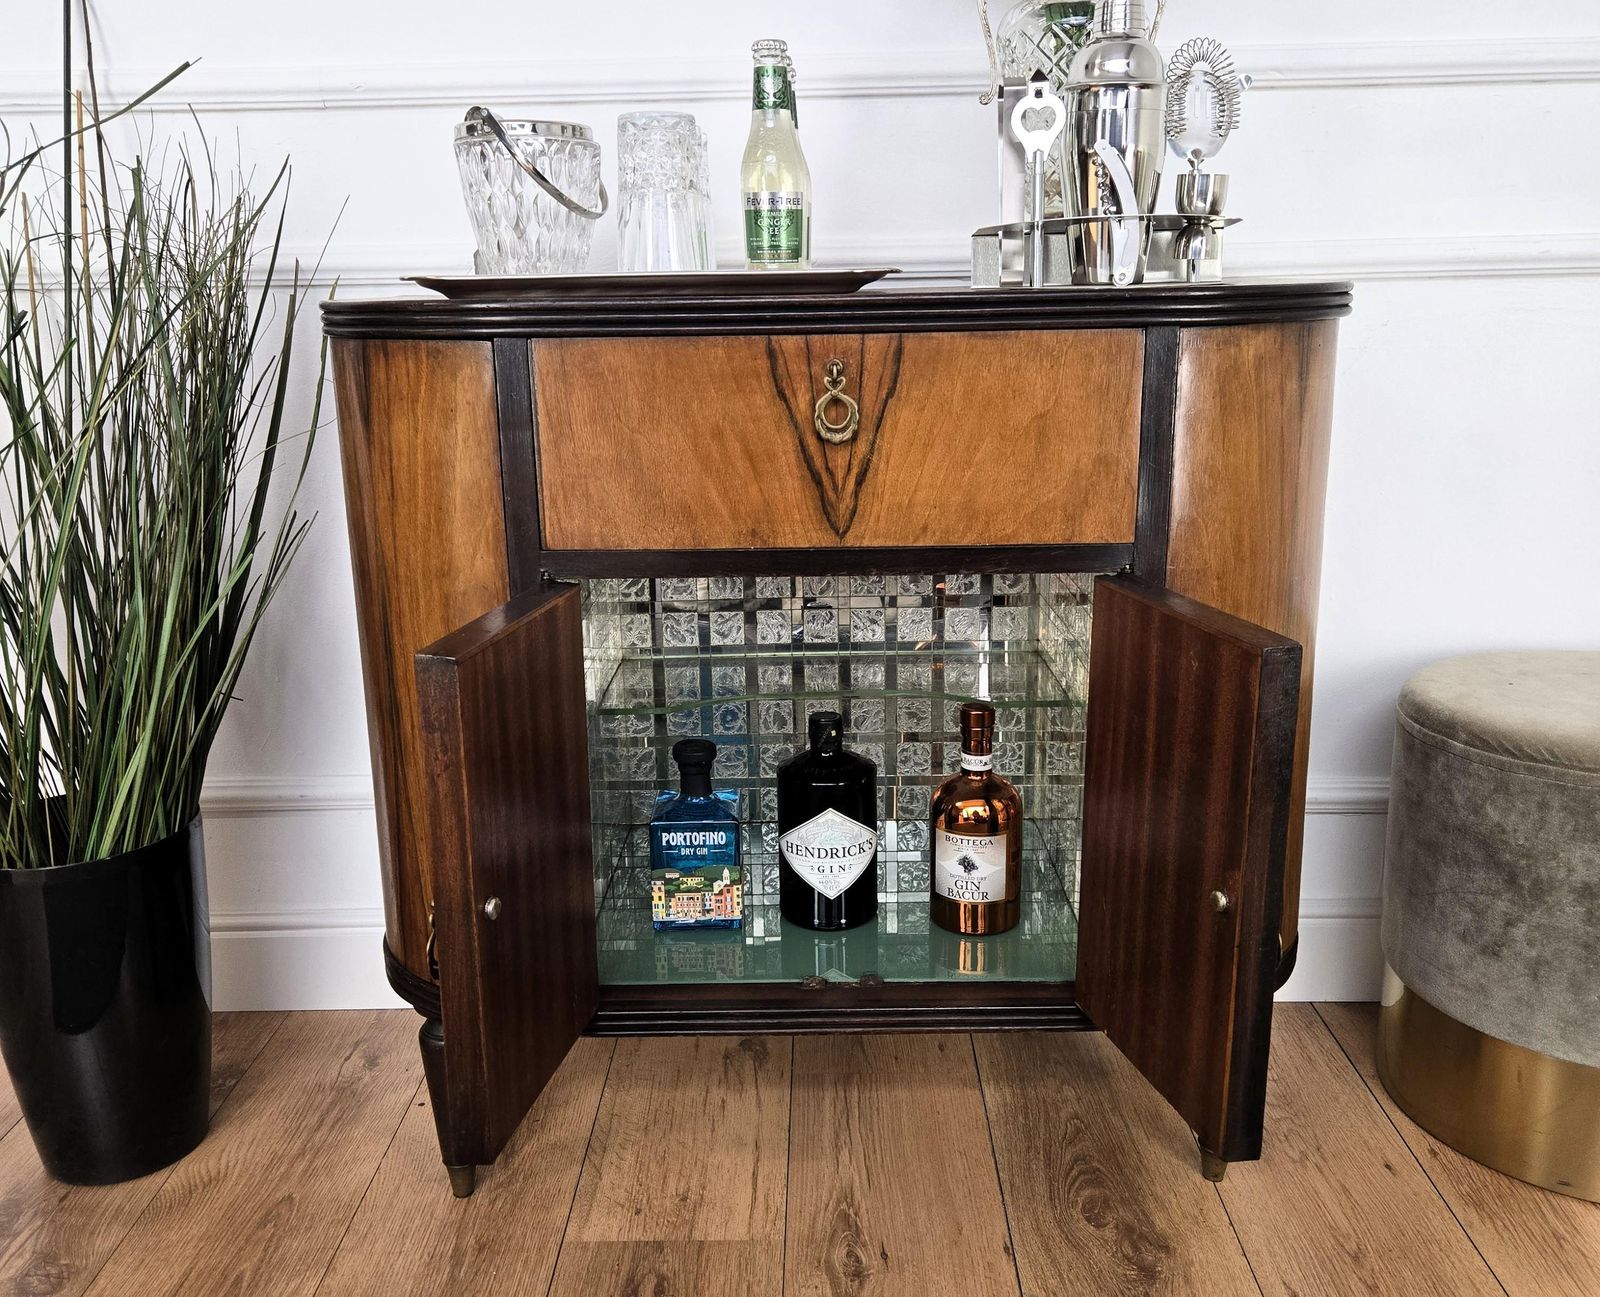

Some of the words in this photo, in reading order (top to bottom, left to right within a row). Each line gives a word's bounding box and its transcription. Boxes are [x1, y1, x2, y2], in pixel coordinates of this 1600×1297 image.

[746, 197, 801, 206] FEVR-TREE
[757, 218, 791, 226] GNGR
[661, 831, 727, 846] PORTOFINO
[945, 834, 994, 846] BOTTEGA
[696, 847, 708, 855] GIN
[785, 837, 873, 860] HENDRICK'S
[817, 864, 846, 874] GIN
[954, 879, 981, 891] GIN
[947, 887, 990, 901] BACUR
